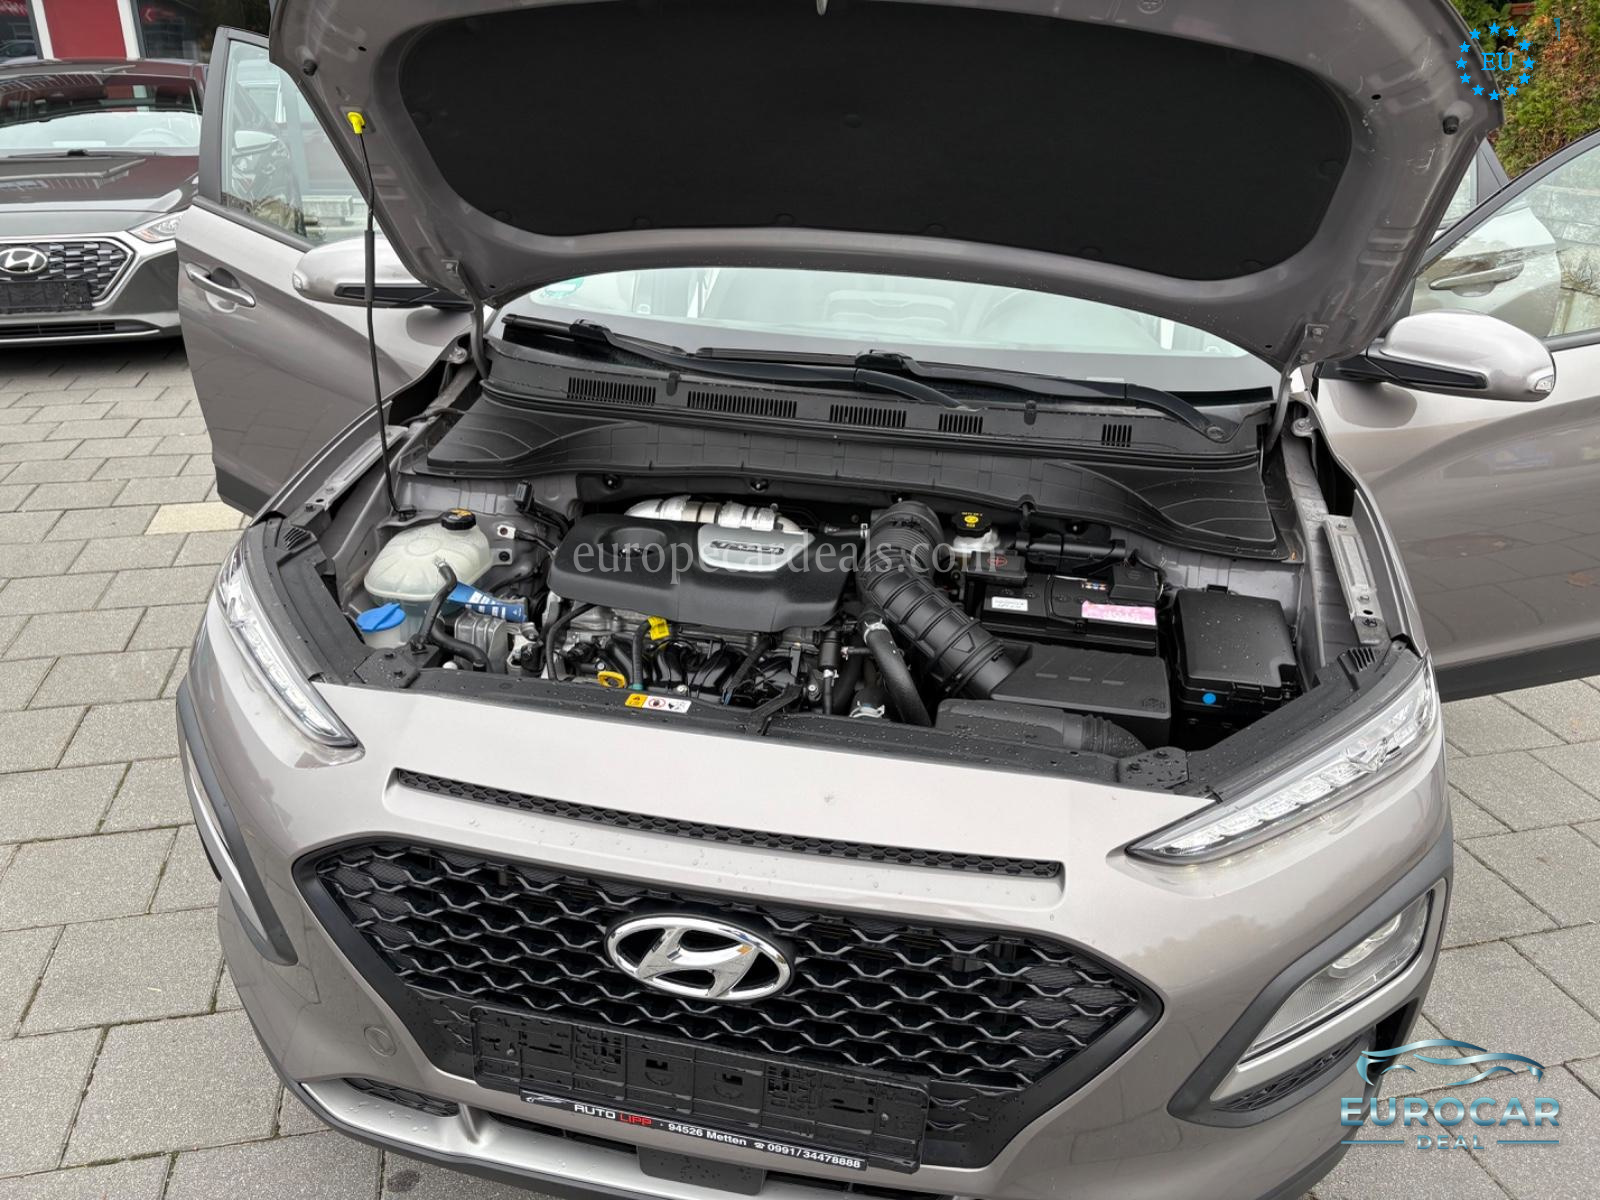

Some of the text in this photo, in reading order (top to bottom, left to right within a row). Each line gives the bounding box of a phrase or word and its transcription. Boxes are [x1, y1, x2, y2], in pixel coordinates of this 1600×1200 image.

[574, 1103, 861, 1169] AUTO LIPP 94526 Metten 0991/34478888
